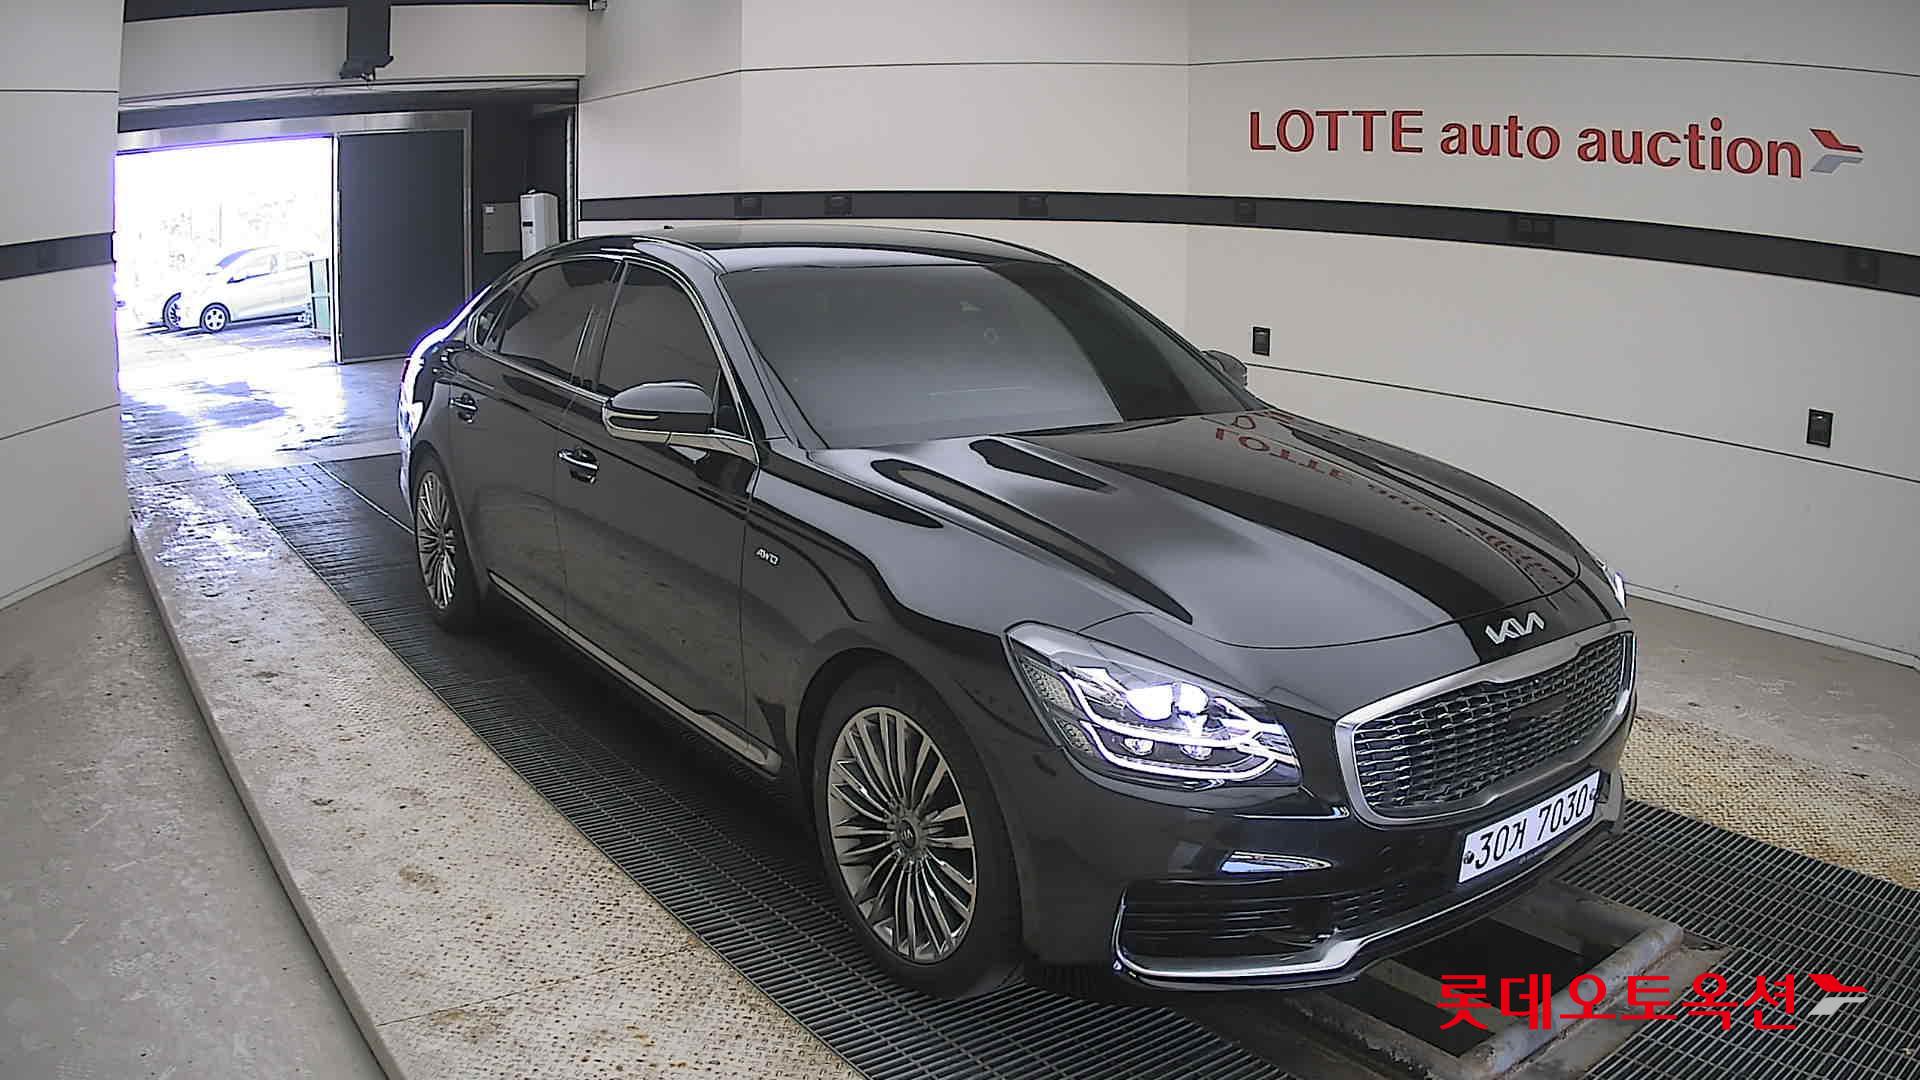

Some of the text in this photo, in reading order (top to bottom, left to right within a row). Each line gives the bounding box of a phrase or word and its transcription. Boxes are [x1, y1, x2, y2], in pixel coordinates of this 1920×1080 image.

[1248, 109, 1803, 178] LOTTE auto auction
[755, 548, 779, 565] AWD
[1485, 611, 1546, 645] KIA
[1475, 783, 1589, 869] 30거 7030
